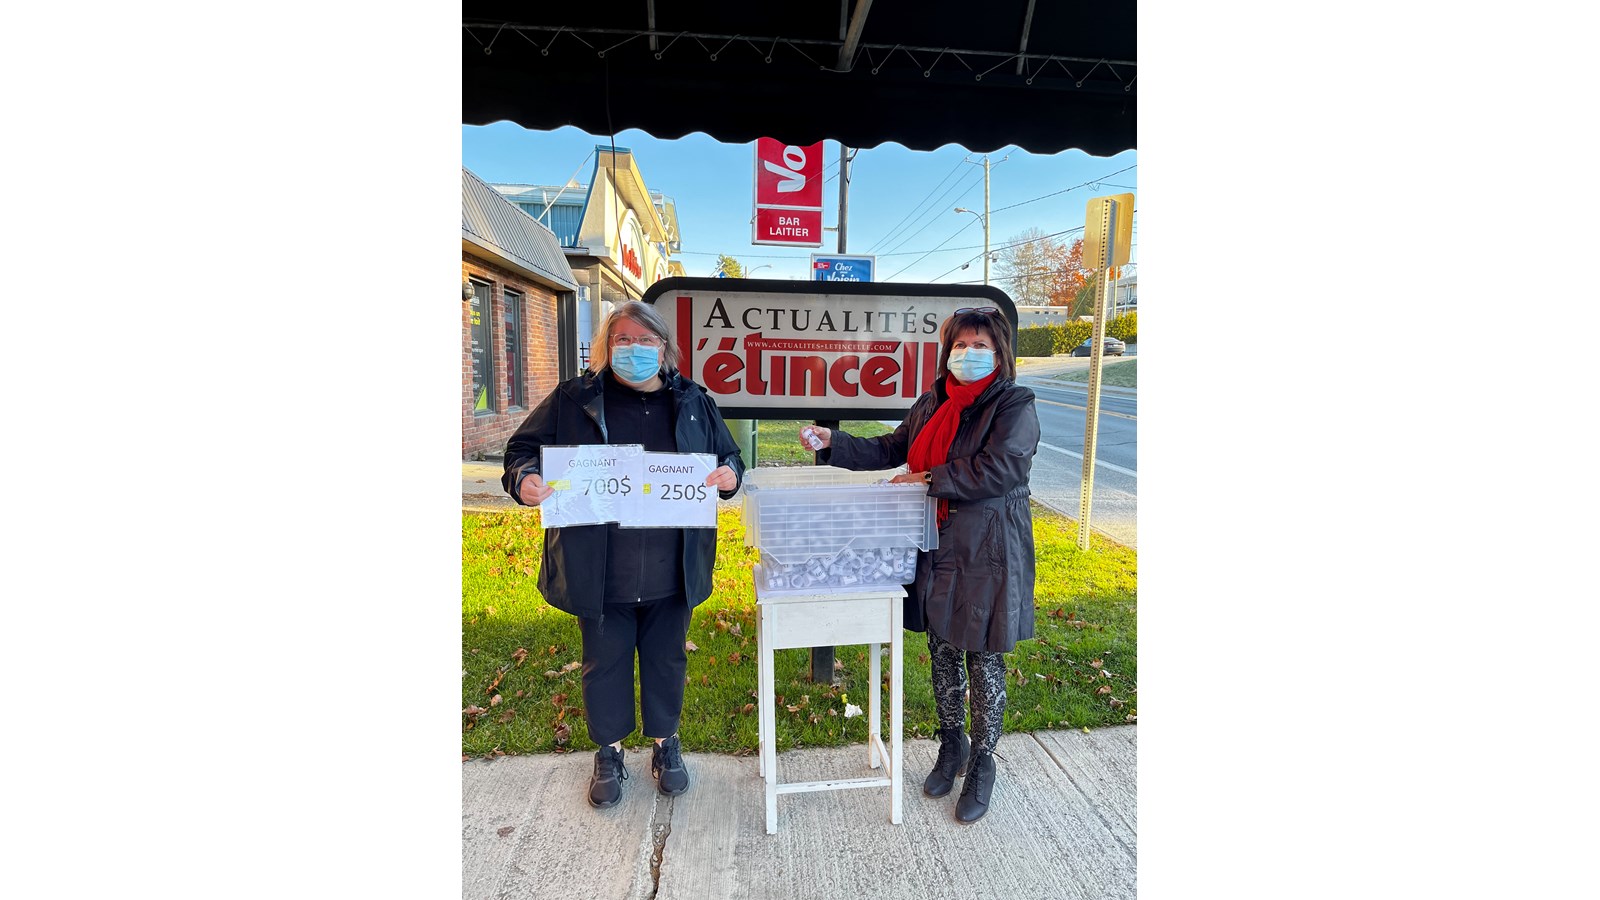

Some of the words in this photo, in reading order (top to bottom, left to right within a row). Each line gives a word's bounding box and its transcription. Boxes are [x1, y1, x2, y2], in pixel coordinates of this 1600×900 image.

[778, 217, 800, 226] BAR
[769, 226, 809, 237] LAITIER
[835, 262, 853, 272] Chez
[568, 458, 617, 468] GAGNANT
[648, 464, 695, 474] GAGNANT
[582, 475, 632, 496] 700$
[660, 483, 707, 503] 250$
